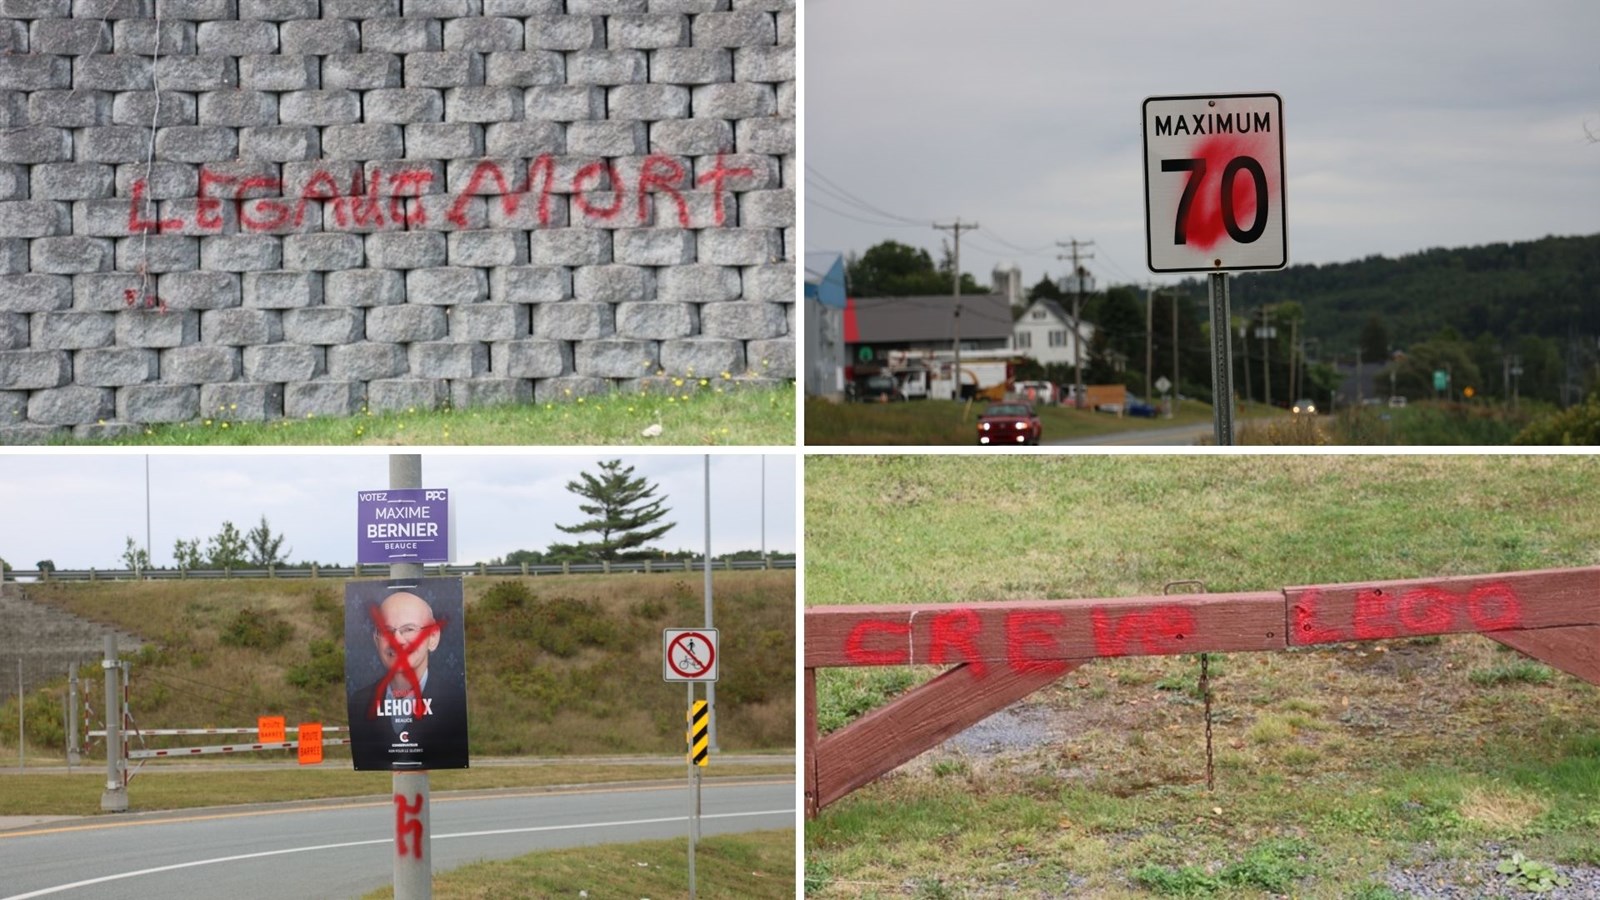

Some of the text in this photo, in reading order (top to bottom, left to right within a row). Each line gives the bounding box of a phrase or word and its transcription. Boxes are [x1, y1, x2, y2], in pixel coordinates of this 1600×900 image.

[1155, 112, 1271, 136] MAXIMUM
[1161, 155, 1269, 245] 70
[360, 490, 446, 502] VOTEZ PPC
[375, 506, 430, 519] MAXIME
[367, 522, 438, 538] BERNIER
[384, 542, 417, 550] BEAUCE
[1294, 581, 1521, 645] LEGO
[376, 698, 433, 717] LEHOUX
